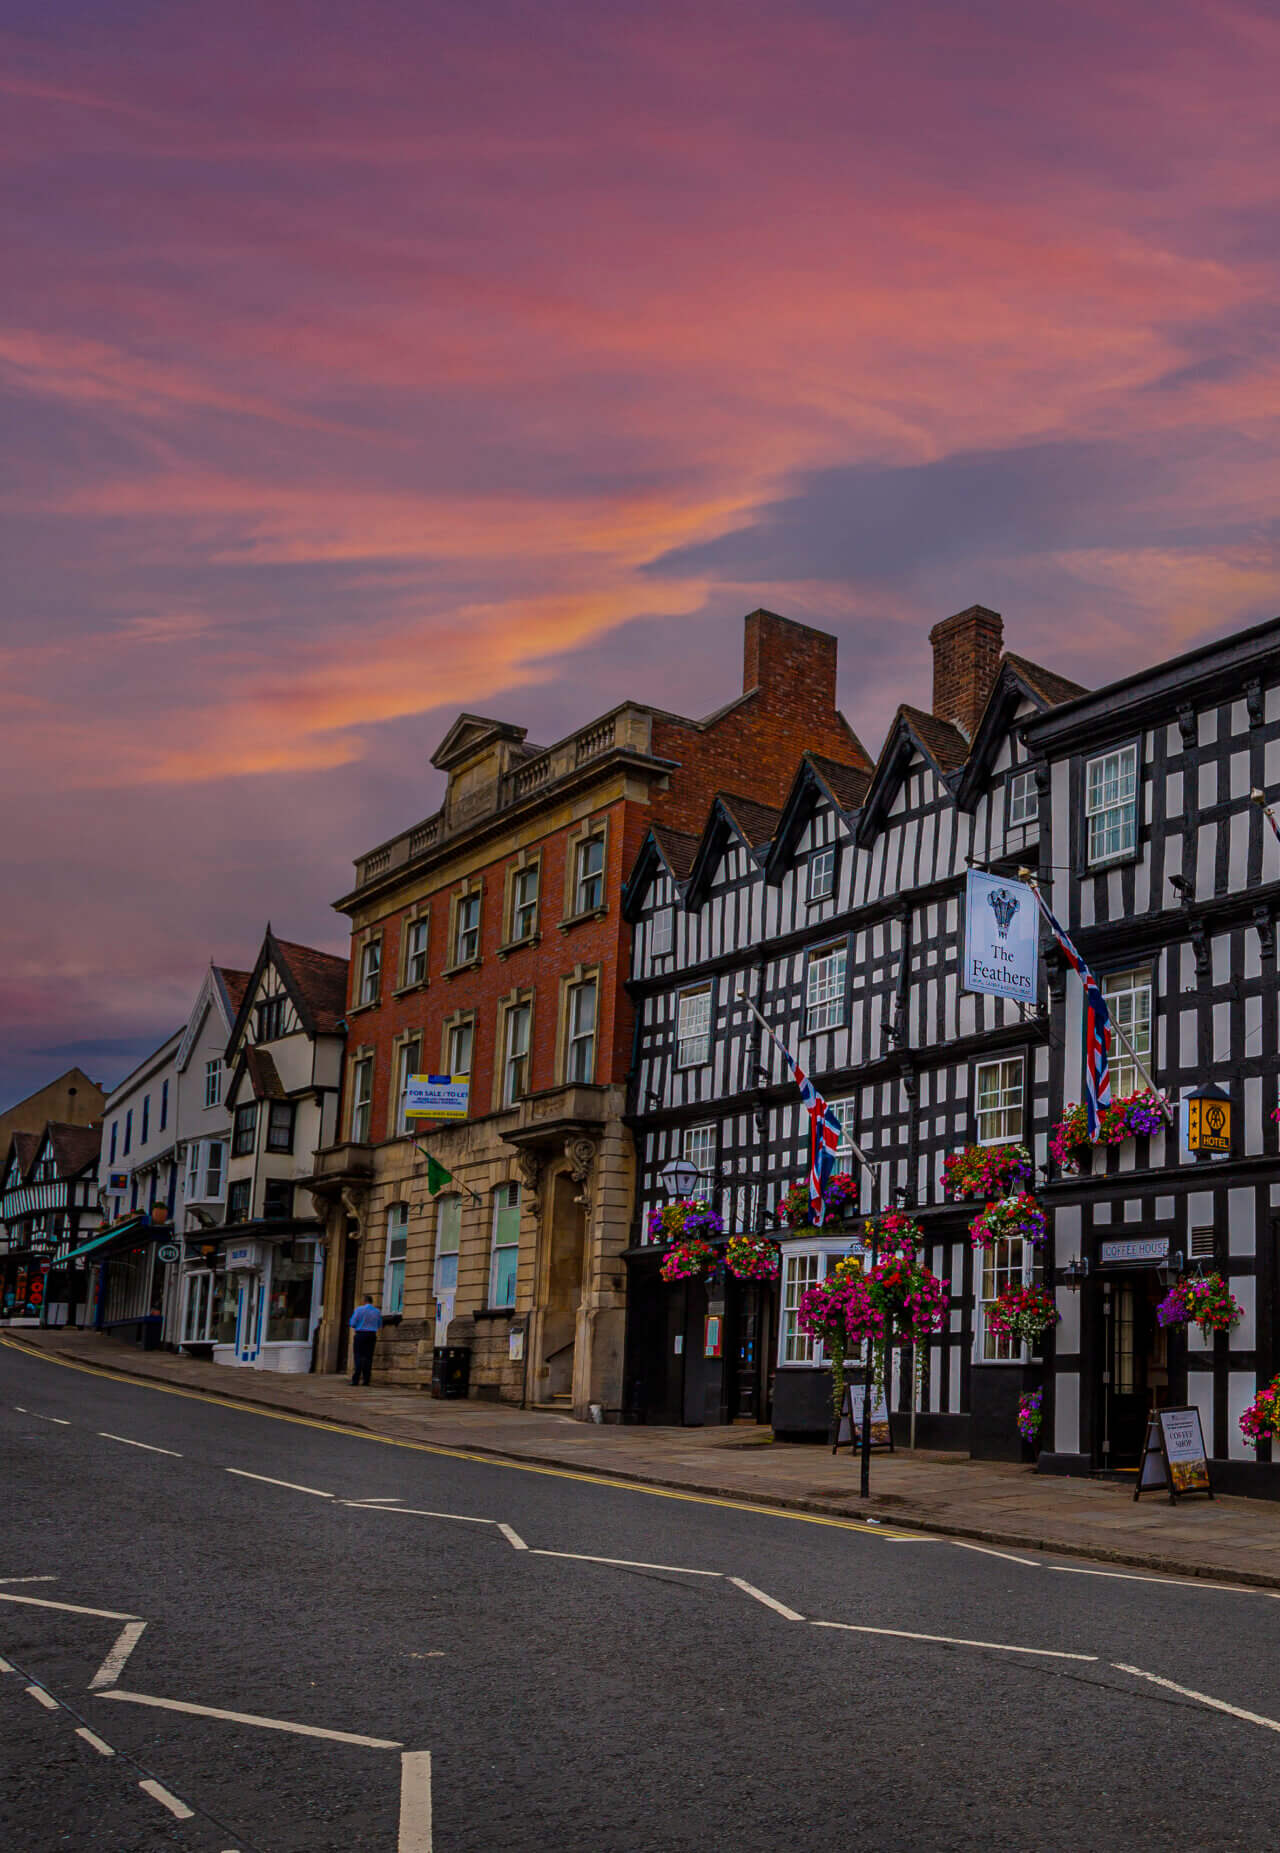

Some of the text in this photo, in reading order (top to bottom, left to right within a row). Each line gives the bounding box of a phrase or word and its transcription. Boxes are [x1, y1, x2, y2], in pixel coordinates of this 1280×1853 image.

[990, 944, 1015, 962] The
[972, 959, 1031, 988] Feathers
[1203, 1136, 1229, 1148] HOTEL
[1105, 1241, 1169, 1257] COFFEE HOUSE
